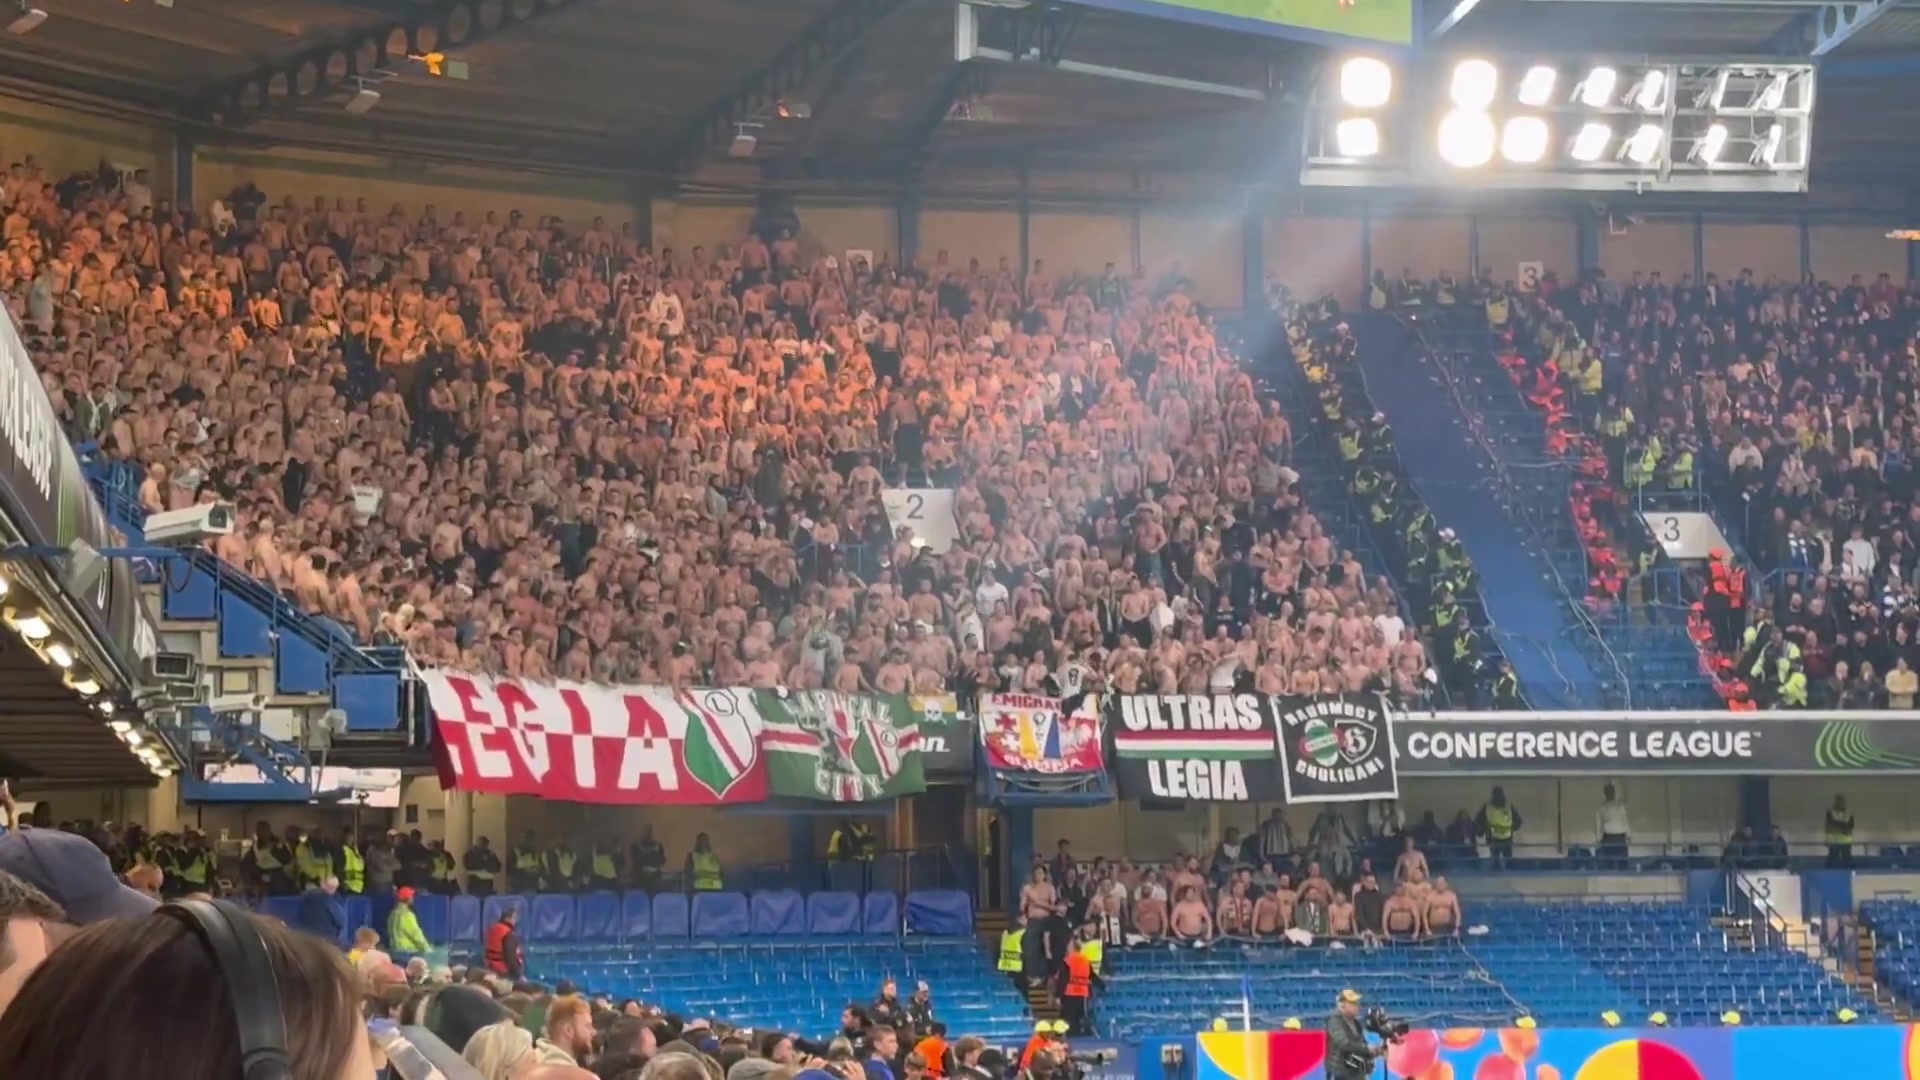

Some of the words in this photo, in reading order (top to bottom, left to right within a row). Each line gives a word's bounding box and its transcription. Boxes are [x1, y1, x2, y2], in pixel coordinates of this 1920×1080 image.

[1523, 266, 1540, 290] 3
[906, 493, 924, 520] 2
[1663, 516, 1681, 542] 3
[1120, 693, 1263, 732] ULTRAS
[445, 675, 679, 790] EGIA
[1407, 731, 1619, 759] CONFERENCE
[1629, 731, 1753, 758] LEAGUE
[1147, 758, 1249, 801] LEGIA
[1756, 877, 1771, 900] 3
